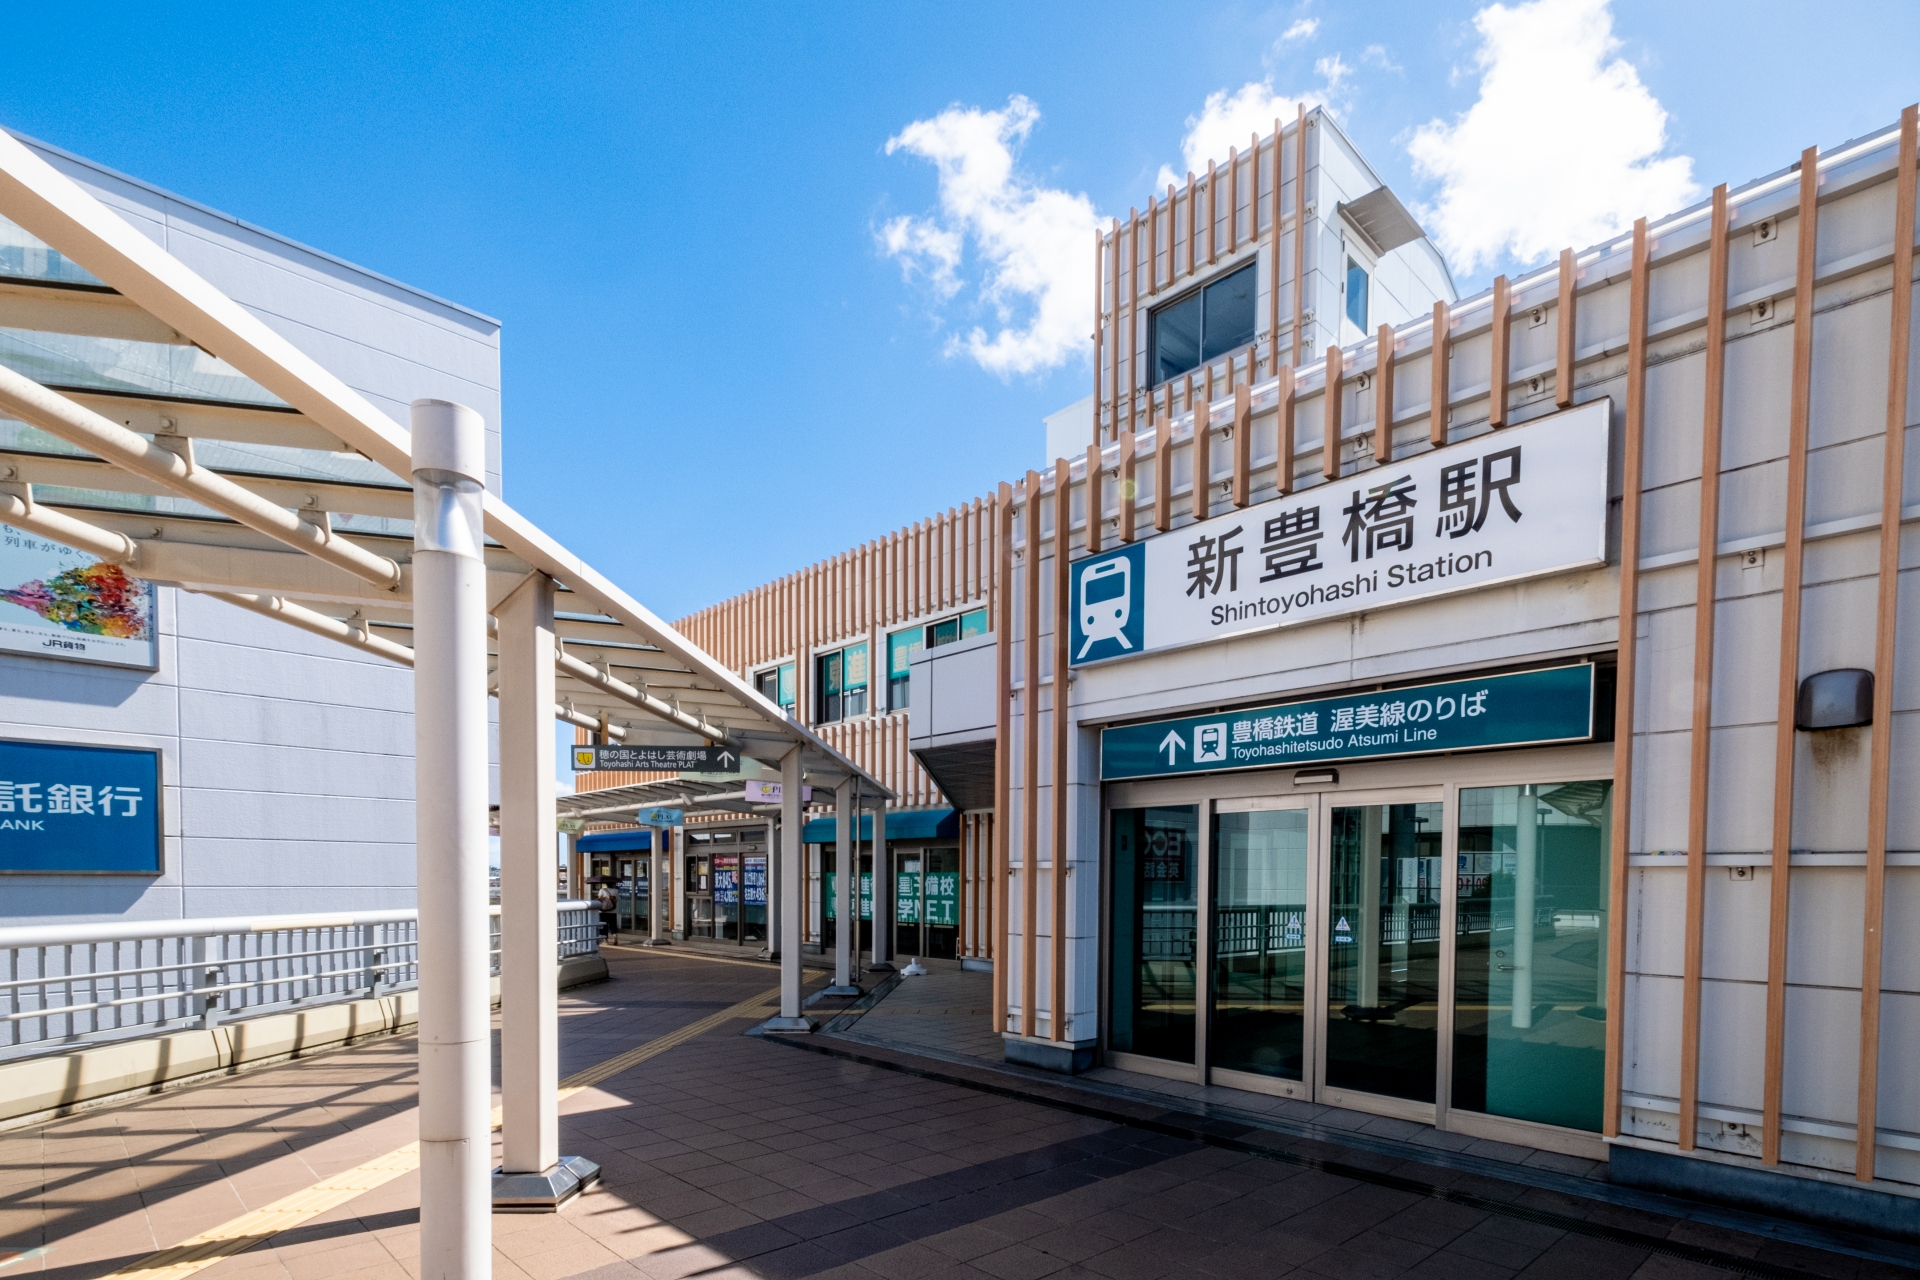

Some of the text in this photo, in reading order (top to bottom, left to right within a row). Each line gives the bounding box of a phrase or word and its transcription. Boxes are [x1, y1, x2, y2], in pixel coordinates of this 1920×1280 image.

[1186, 445, 1523, 599] 新豊橋駅
[1211, 549, 1493, 626] Shintoyohashi Station
[42, 639, 86, 651] JR貨物
[1231, 689, 1489, 744] 豊橋鉄道 渥美線のりば
[599, 750, 707, 761] 穂の国とよはし芸術劇場
[1231, 727, 1438, 761] Toyohashitetsudo Atsumi Line
[600, 760, 634, 769] Toyohashi
[635, 760, 650, 769] Arts
[651, 760, 677, 769] Theatre
[0, 781, 142, 816] 託銀行
